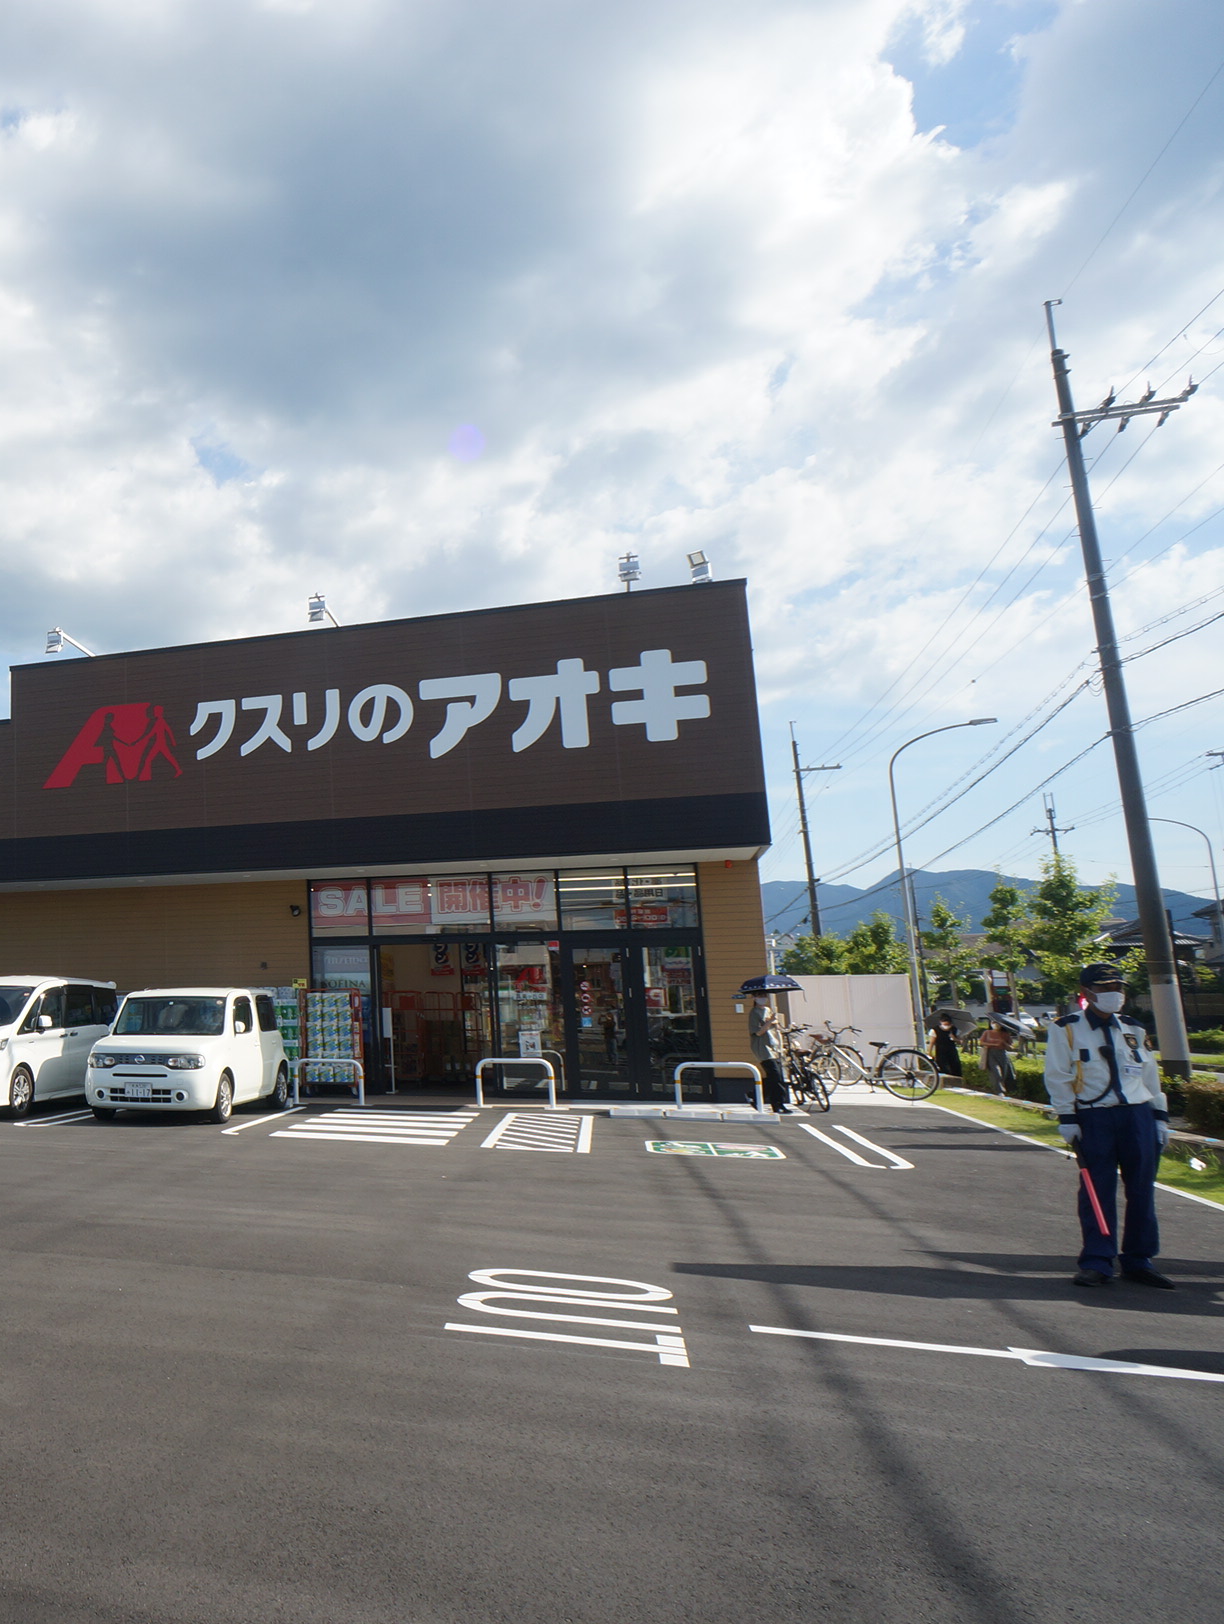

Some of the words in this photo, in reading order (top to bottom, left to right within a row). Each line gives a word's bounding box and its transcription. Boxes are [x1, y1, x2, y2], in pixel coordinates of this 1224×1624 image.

[189, 648, 710, 761] クスリのアオキ
[319, 884, 425, 917] SALE
[444, 1268, 690, 1368] OUT
